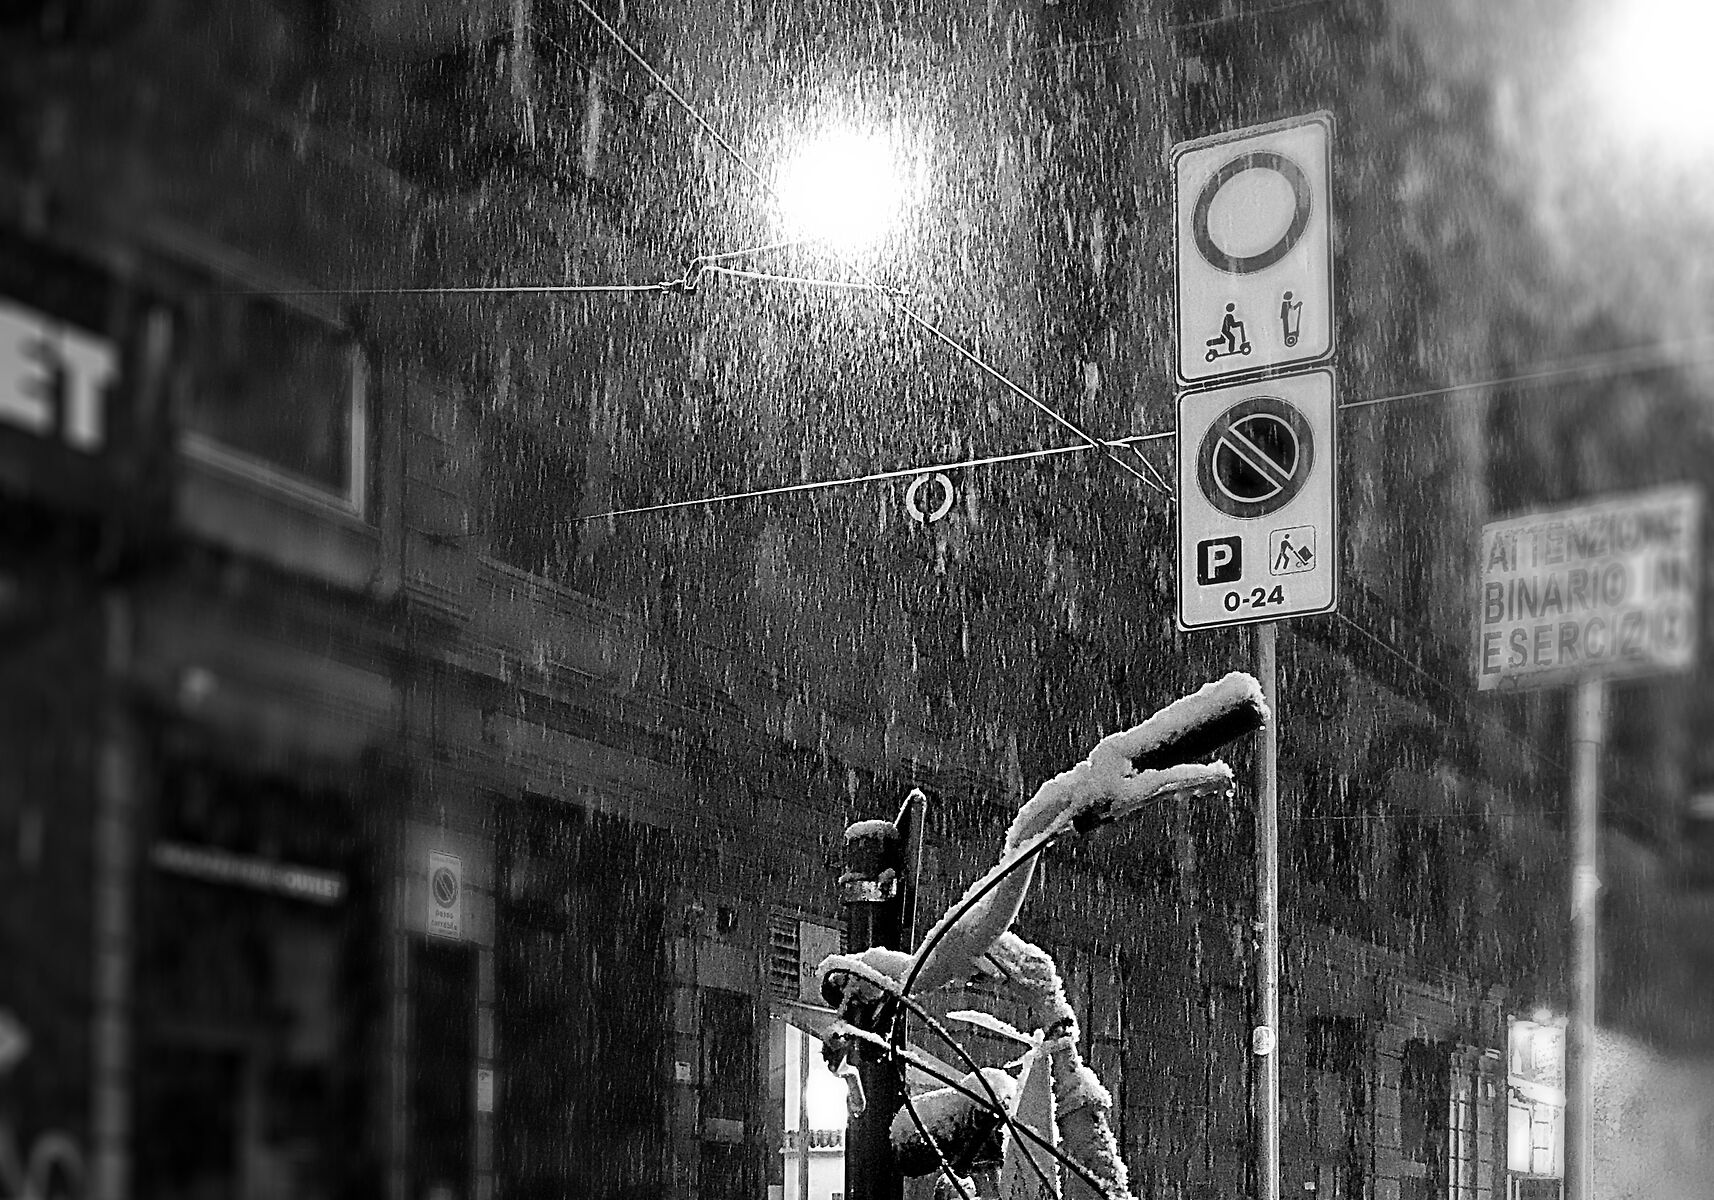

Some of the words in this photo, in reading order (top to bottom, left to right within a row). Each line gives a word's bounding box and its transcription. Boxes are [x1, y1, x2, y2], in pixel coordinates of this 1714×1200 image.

[1206, 543, 1233, 580] P
[1224, 584, 1285, 612] 0-24
[1485, 562, 1627, 625] BINARIO
